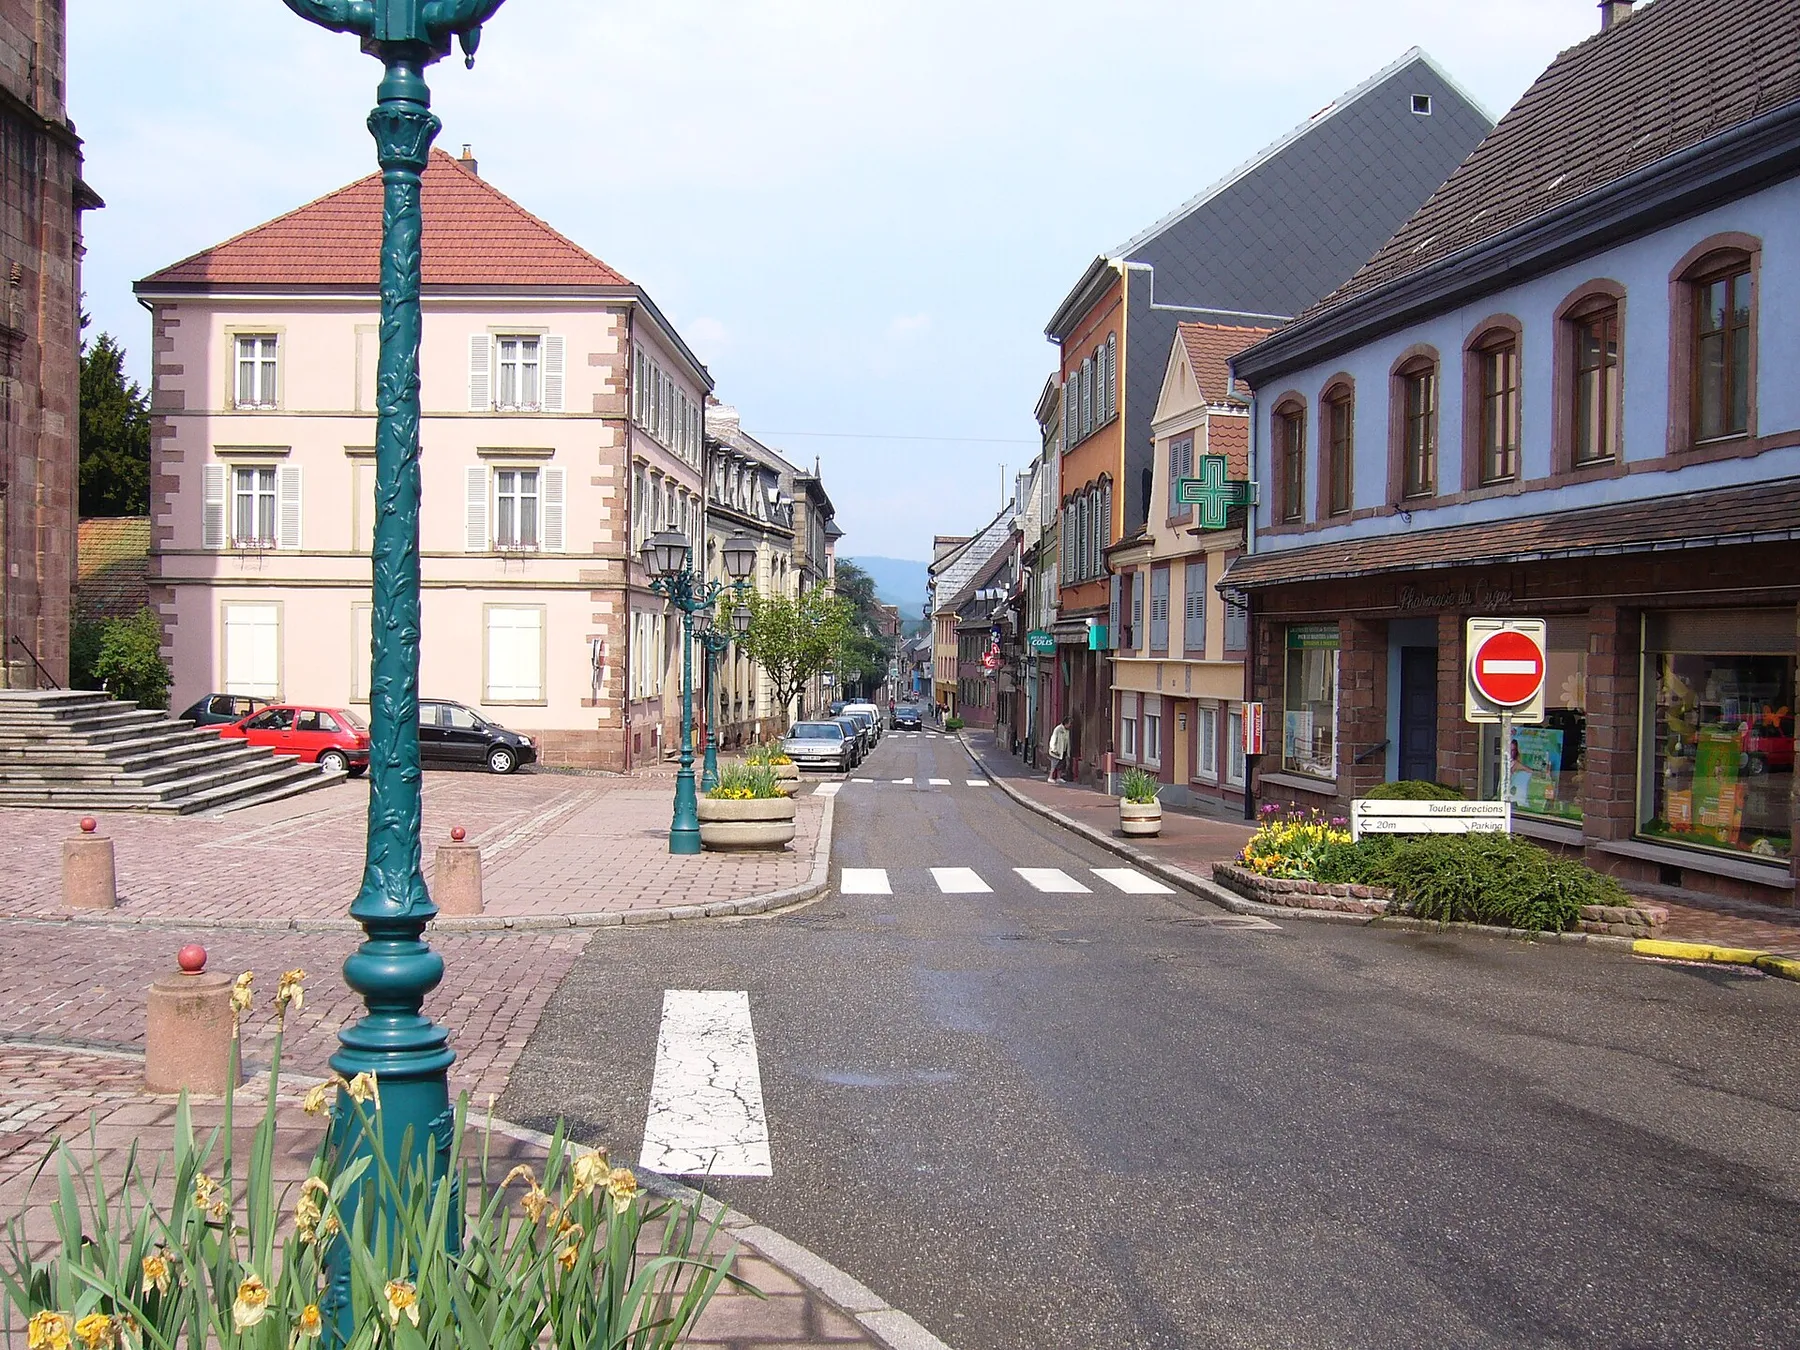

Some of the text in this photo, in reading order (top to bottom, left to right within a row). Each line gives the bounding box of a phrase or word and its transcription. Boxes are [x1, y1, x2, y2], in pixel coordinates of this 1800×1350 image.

[1399, 585, 1455, 611] Pharmacie
[1458, 584, 1472, 606] du
[1428, 804, 1504, 813] Toutes directions
[1376, 820, 1503, 831] 20m Parking
